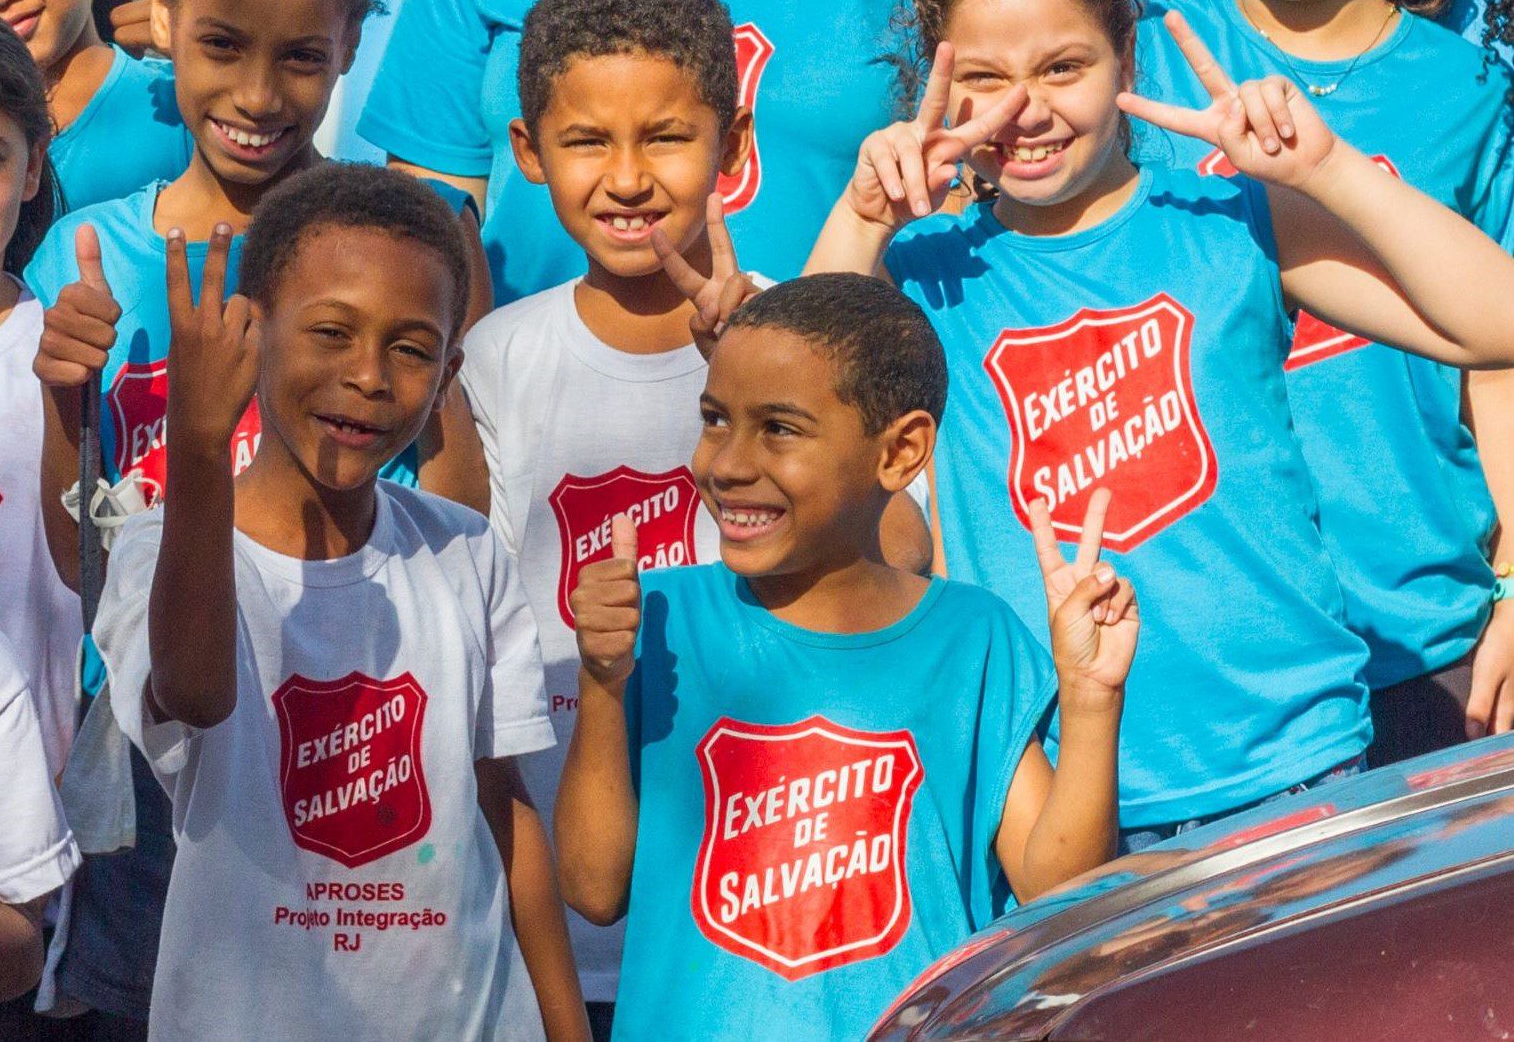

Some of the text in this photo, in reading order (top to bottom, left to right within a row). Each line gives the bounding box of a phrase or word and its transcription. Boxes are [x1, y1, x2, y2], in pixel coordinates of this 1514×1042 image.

[1023, 318, 1162, 442] EXÉRCITO
[1088, 391, 1119, 432] DE
[1033, 389, 1181, 513] SALVAÇÃO
[576, 485, 679, 563] EXÉCITO
[297, 694, 406, 769] EXÉRCITO
[347, 745, 371, 774] DE
[294, 755, 411, 827] SALVAÇÃO
[723, 754, 895, 841] EXÉRCITO
[793, 812, 829, 848] DE
[306, 882, 404, 902] APROSES
[719, 830, 891, 924] SALVAÇÃO
[274, 907, 446, 931] Projeto Integração
[334, 933, 361, 952] RJ
